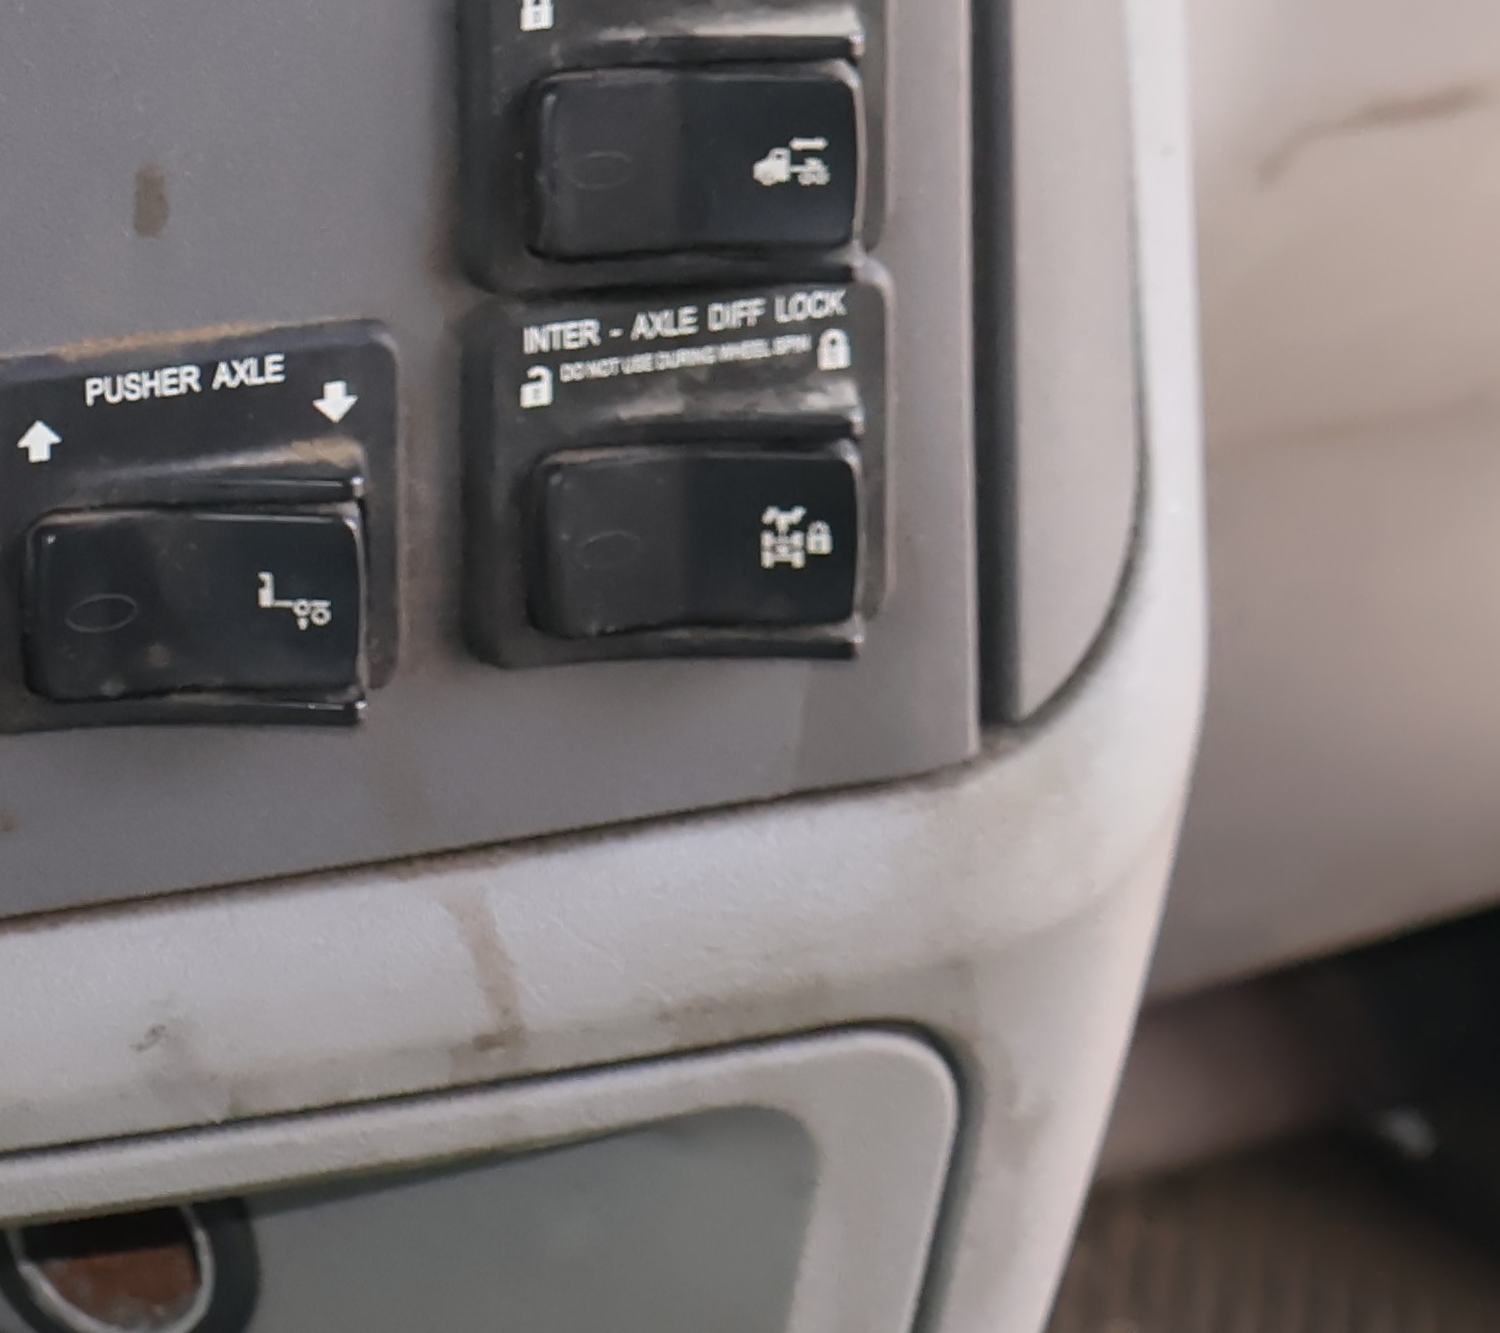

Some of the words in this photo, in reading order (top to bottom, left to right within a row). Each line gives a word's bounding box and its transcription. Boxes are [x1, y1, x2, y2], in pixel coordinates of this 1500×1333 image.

[523, 319, 601, 354] INTER
[630, 305, 699, 341] AXLE
[707, 298, 766, 332] DIFF
[774, 289, 847, 322] LOCK
[85, 365, 201, 406] PUSHER
[212, 353, 286, 390] AXLE
